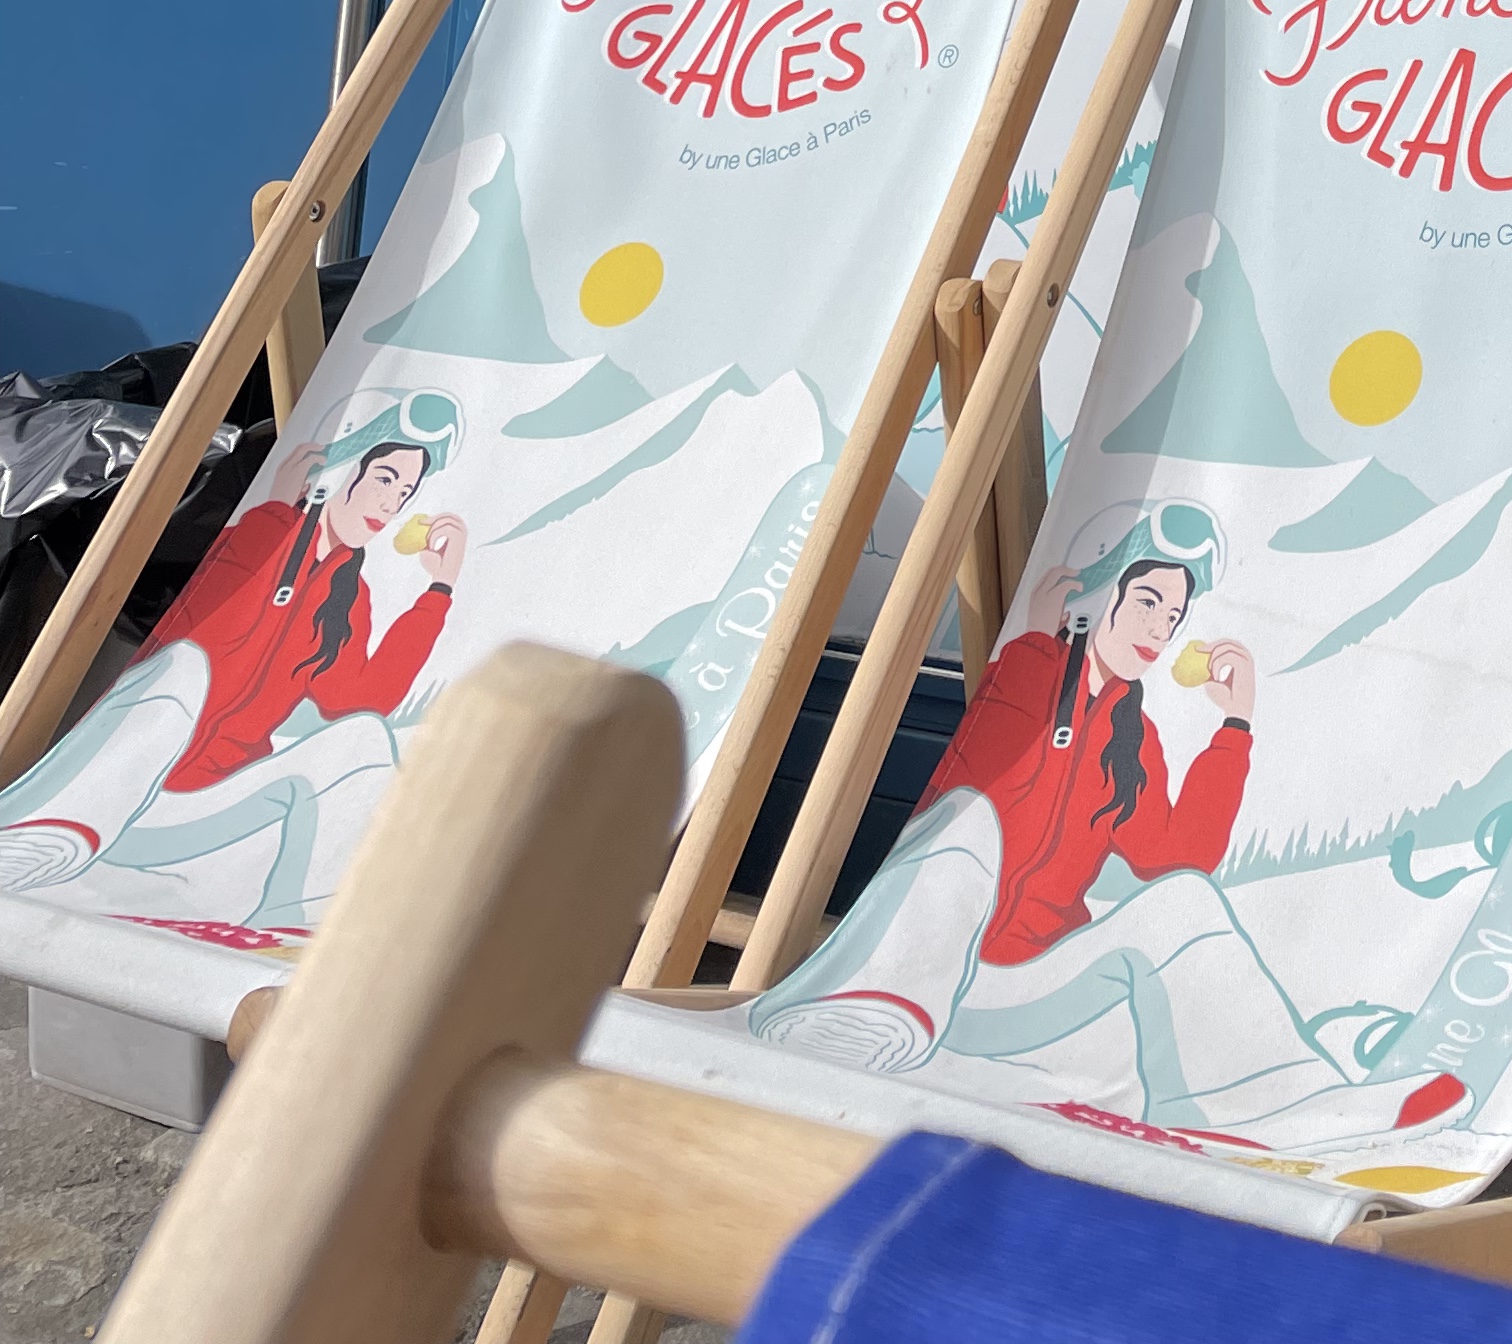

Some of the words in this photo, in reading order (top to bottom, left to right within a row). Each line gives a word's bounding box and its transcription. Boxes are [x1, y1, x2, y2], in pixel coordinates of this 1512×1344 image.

[679, 144, 704, 170] by
[706, 150, 741, 171] une
[745, 138, 802, 169] Glace
[806, 130, 820, 151] à
[823, 107, 873, 145] Paris
[1419, 220, 1447, 248] by
[1450, 228, 1491, 250] une
[688, 661, 735, 692] à
